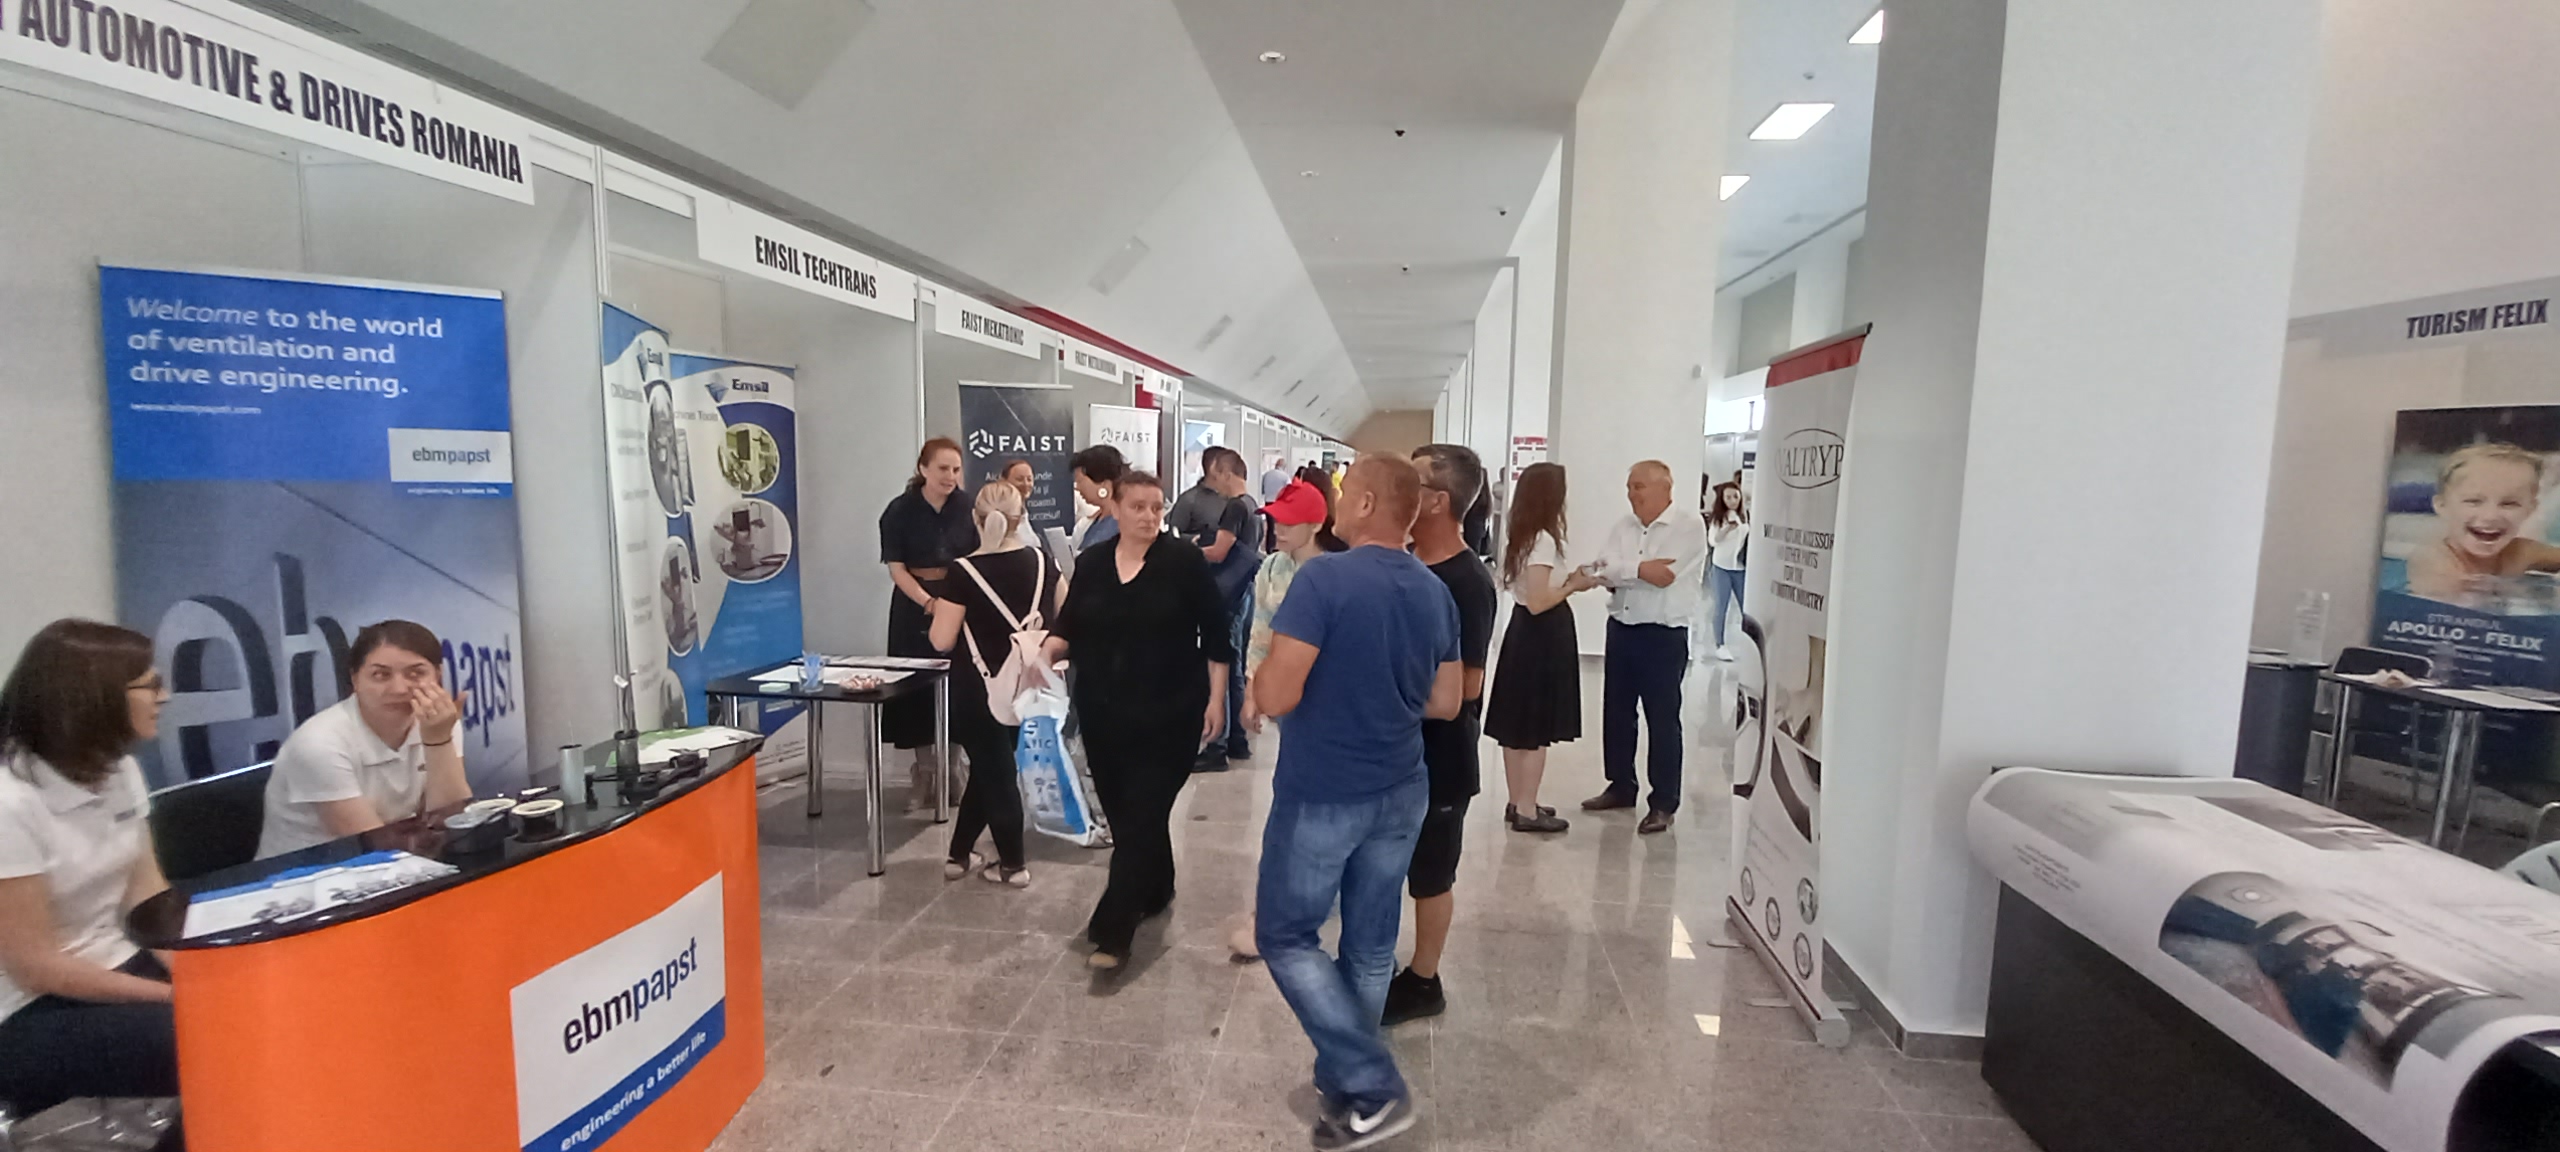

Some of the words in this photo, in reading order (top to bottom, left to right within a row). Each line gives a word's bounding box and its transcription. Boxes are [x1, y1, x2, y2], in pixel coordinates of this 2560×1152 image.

[19, 0, 263, 105] AUTOMOTIVE
[269, 70, 295, 116] &
[299, 71, 405, 148] DRIVES
[409, 109, 524, 184] ROMANIA
[754, 234, 801, 276] EMSIL
[803, 251, 877, 300] TECHTRANS
[127, 297, 259, 327] Welcome
[266, 308, 299, 329] to
[307, 309, 357, 333] the
[363, 316, 443, 338] world
[961, 309, 982, 334] FAIST
[2406, 307, 2489, 339] TURISM
[2491, 298, 2550, 330] FELIX
[127, 329, 164, 350] of
[168, 333, 335, 362] ventilation
[342, 343, 396, 364] and
[129, 360, 211, 385] drive
[218, 366, 408, 399] engineering.
[732, 378, 770, 393] Emsil
[412, 446, 492, 465] ebmpapst
[998, 435, 1066, 452] FAIST
[1115, 431, 1151, 443] FAIST
[2387, 620, 2466, 640] APOLLO
[2485, 631, 2545, 651] FELIX
[562, 936, 699, 1055] ebmpapst
[560, 1083, 645, 1151] engineering
[646, 1076, 655, 1089] a
[657, 1046, 690, 1082] better
[690, 1031, 707, 1052] life
